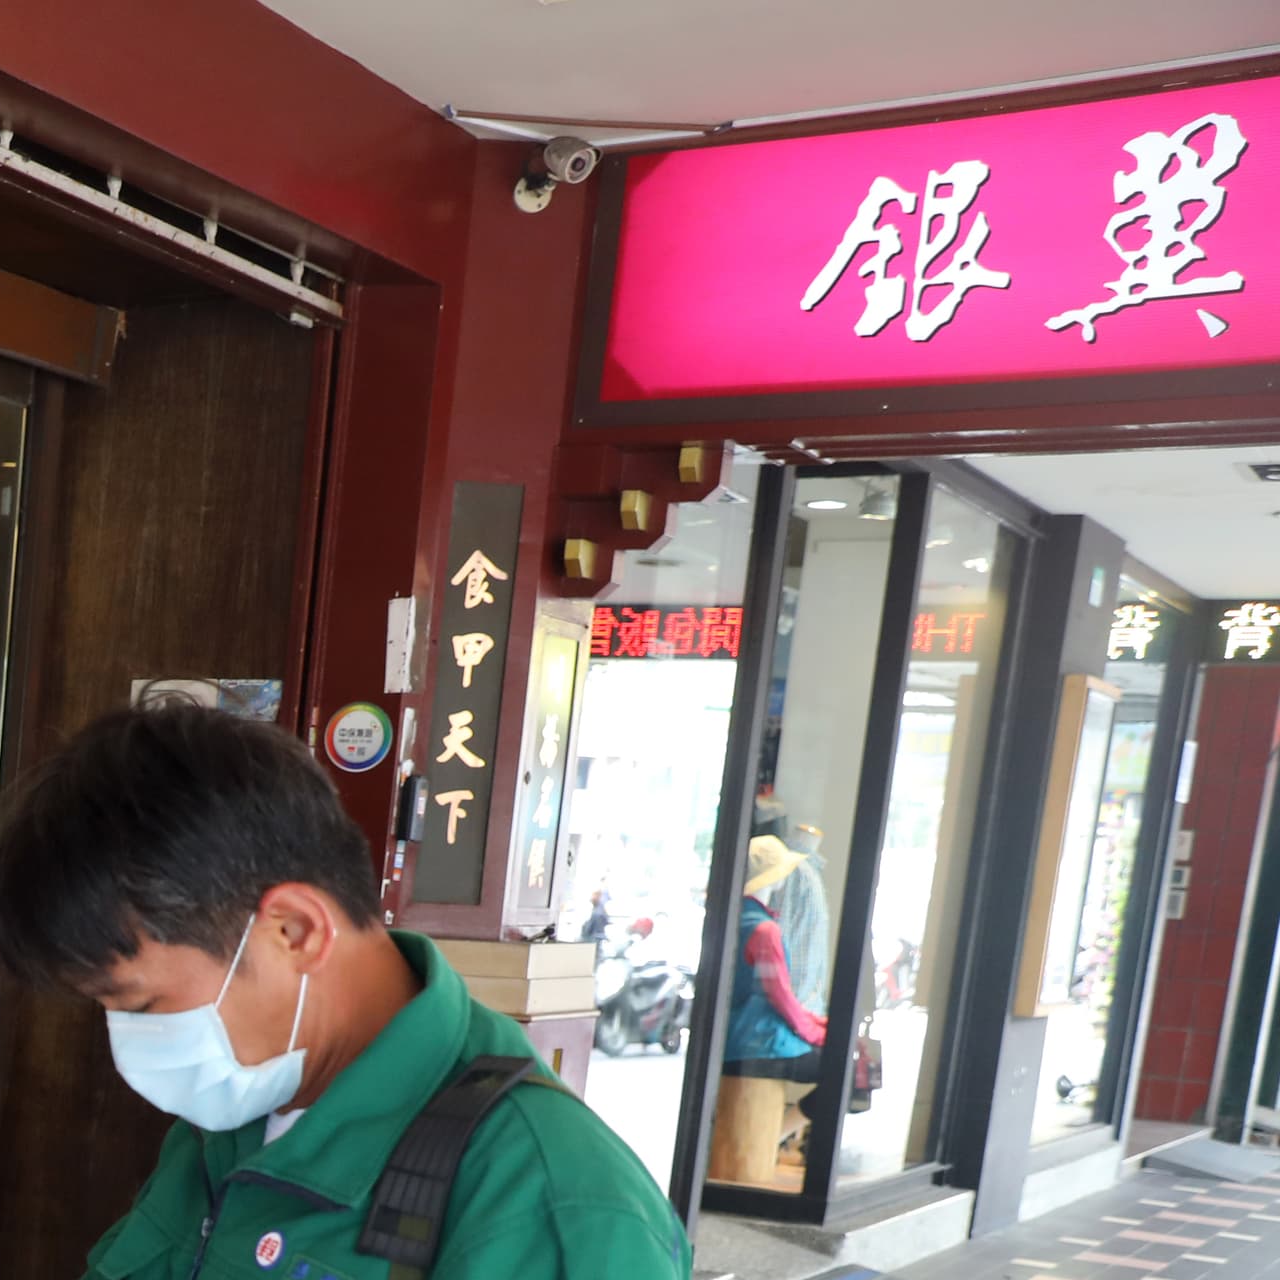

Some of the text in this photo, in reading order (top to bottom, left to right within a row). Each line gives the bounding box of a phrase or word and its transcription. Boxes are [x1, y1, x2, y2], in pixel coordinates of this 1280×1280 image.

[799, 111, 1247, 342] 銀翼
[434, 549, 509, 845] 食甲天下
